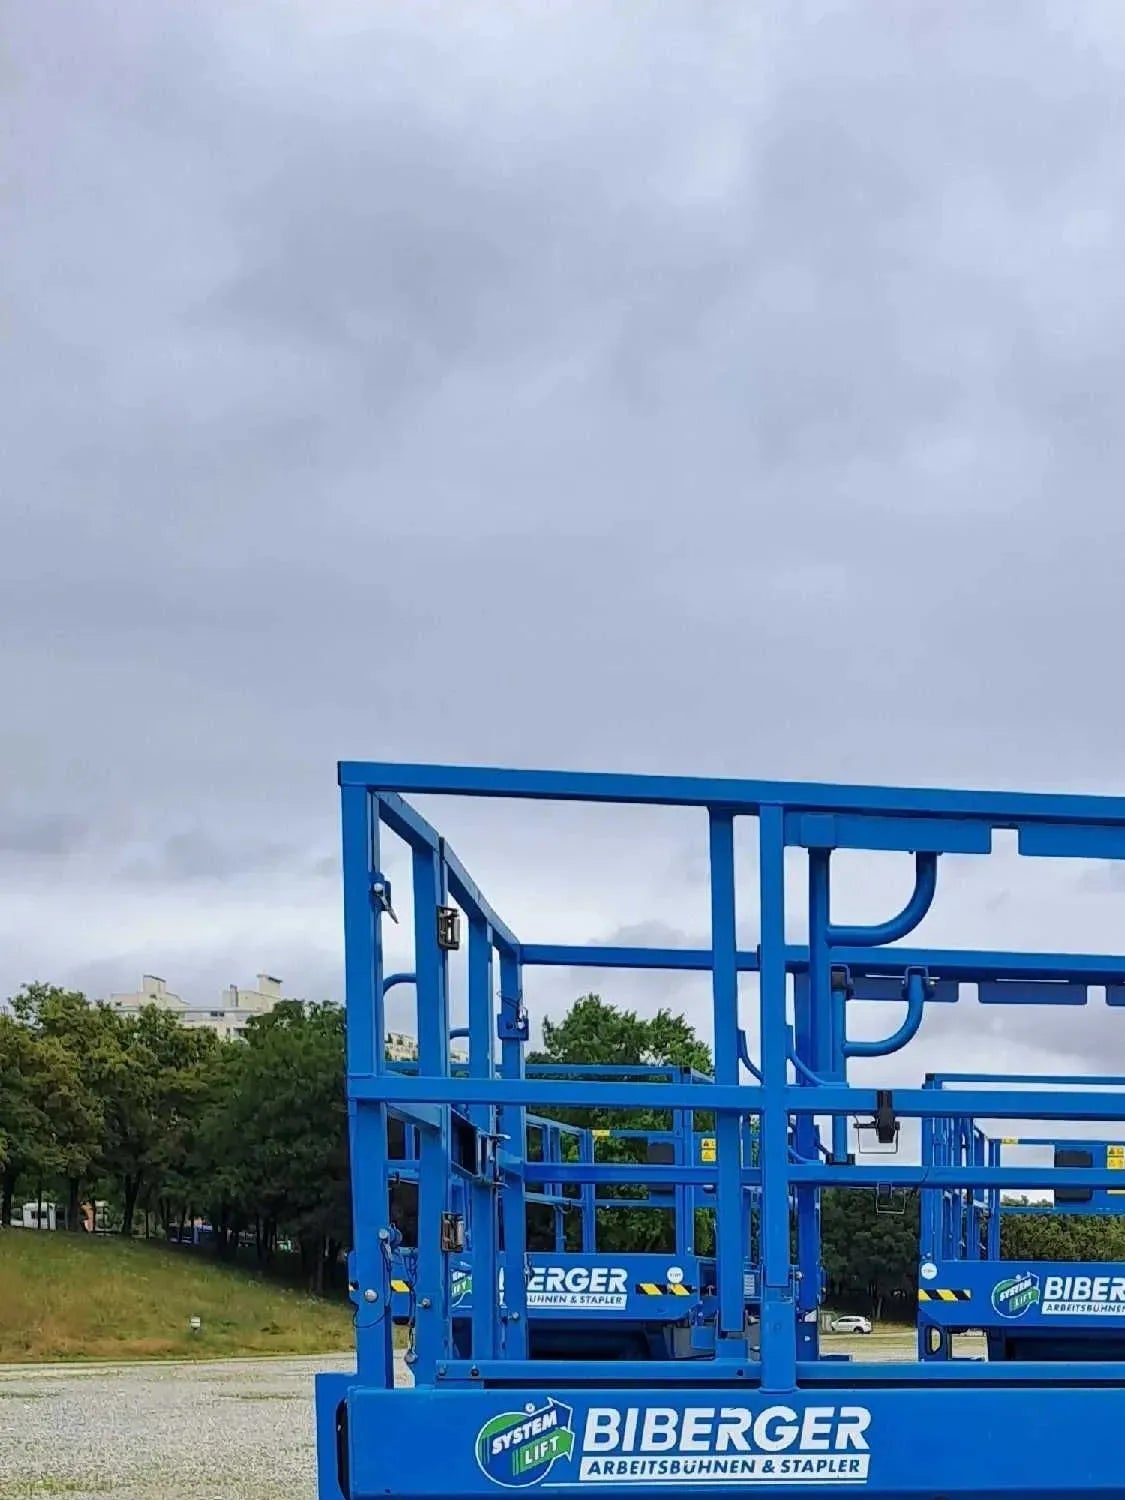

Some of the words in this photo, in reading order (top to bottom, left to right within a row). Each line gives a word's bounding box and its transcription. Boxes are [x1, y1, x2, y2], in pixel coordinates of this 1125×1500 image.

[1015, 1291, 1033, 1306] LIFT
[491, 1409, 558, 1456] SYSTEM
[583, 1405, 872, 1452] BIBERGER
[523, 1434, 561, 1465] LIFT
[587, 1458, 755, 1475] ARBEITSBÜHNEN
[761, 1459, 776, 1474] &
[781, 1458, 860, 1474] STAPLER
